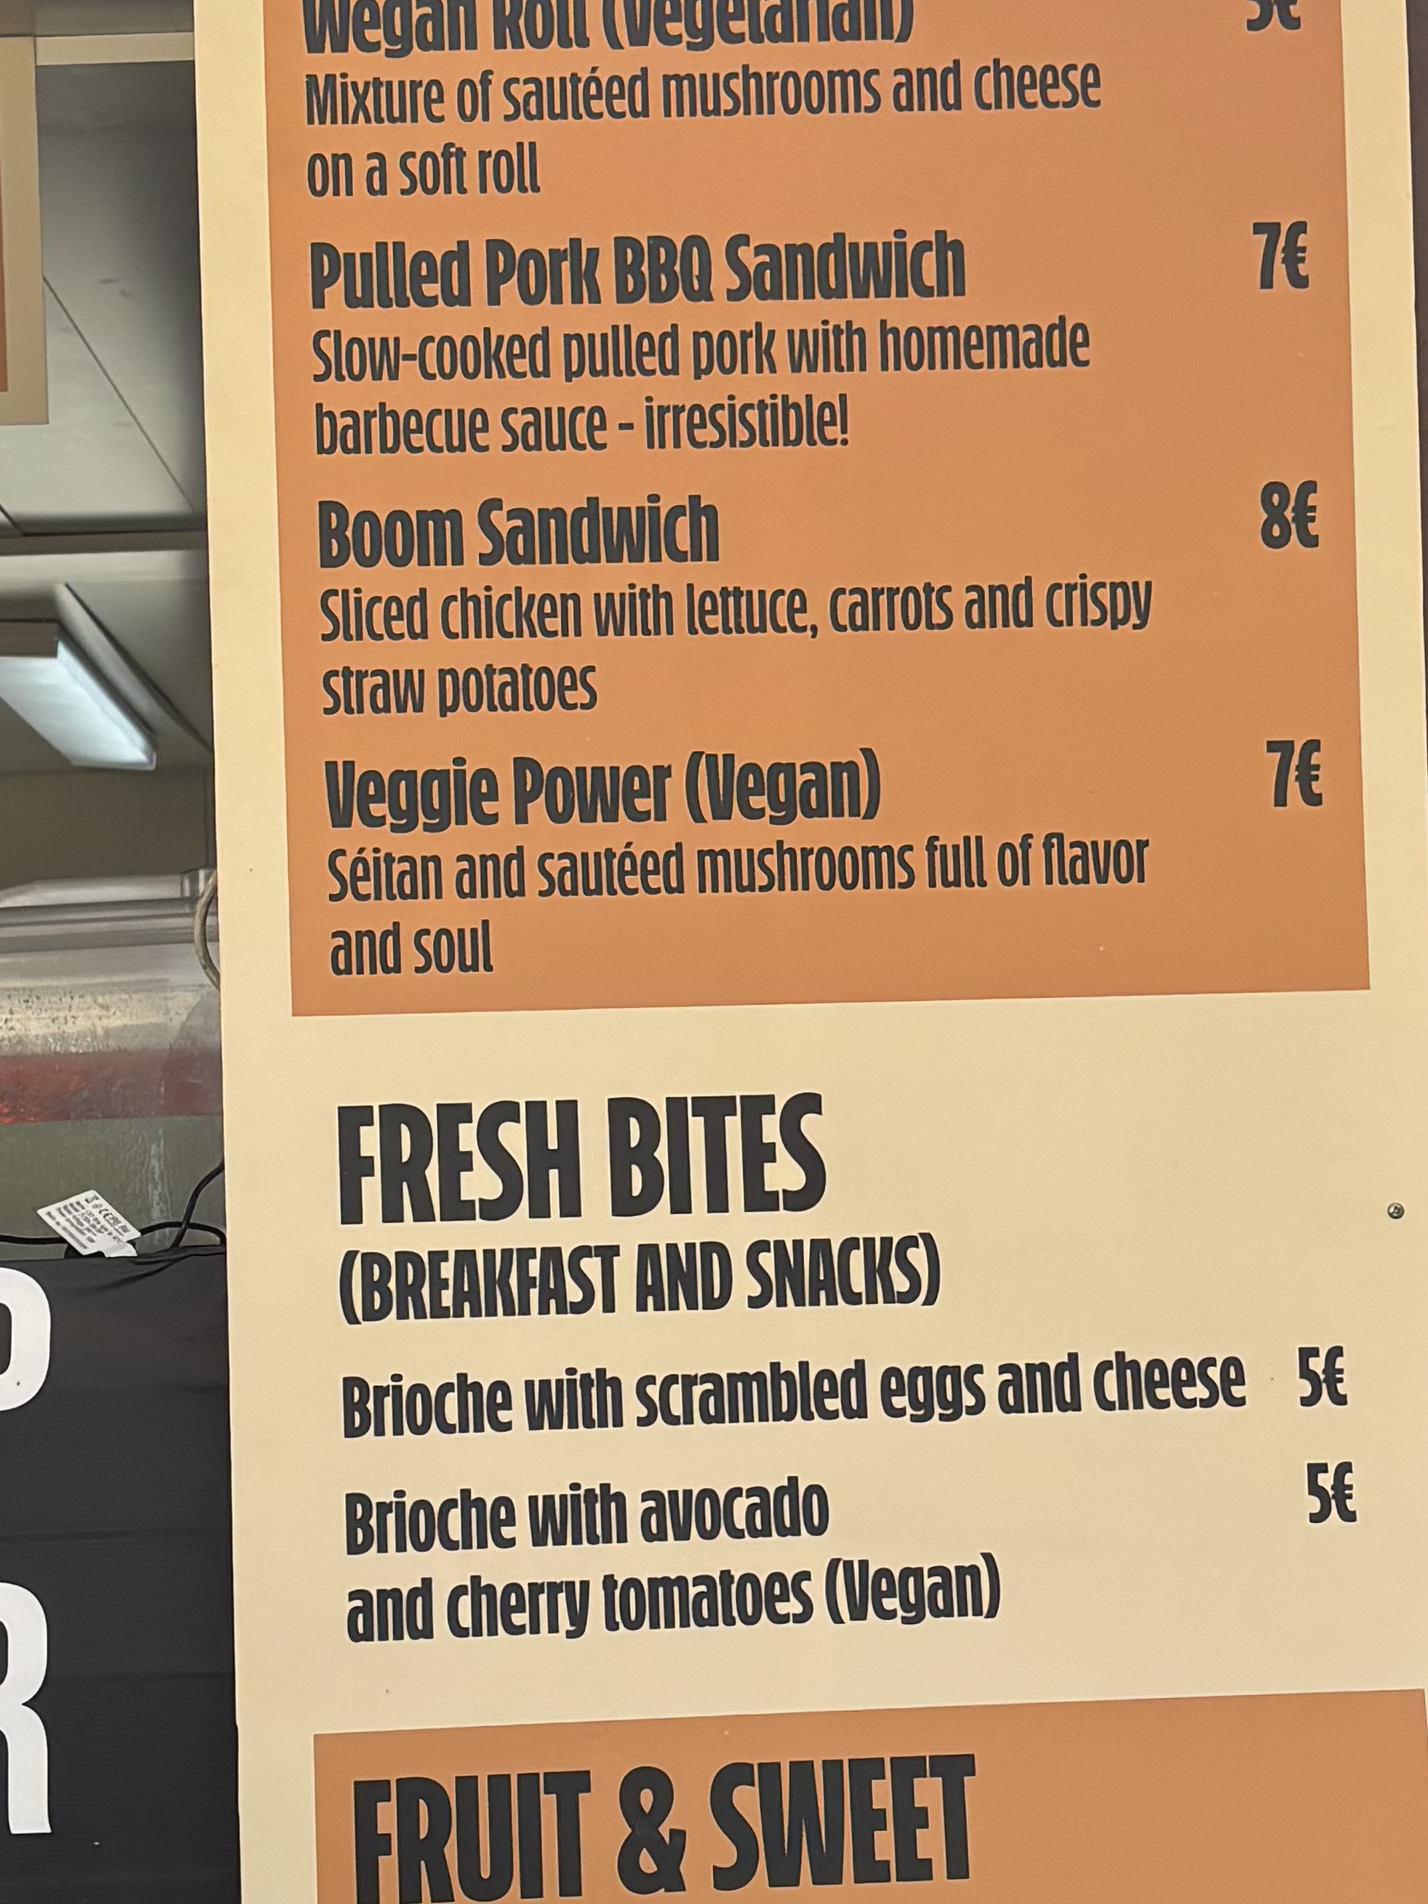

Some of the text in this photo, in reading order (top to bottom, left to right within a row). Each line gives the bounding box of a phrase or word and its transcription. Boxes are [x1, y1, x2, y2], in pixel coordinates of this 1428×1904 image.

[305, 57, 1102, 126] Mixture of sautéed mushrooms and cheese
[307, 141, 541, 198] on a soft roll
[310, 228, 967, 310] Pulled Pork BBQ Sandwich
[1252, 220, 1310, 290] 7€
[312, 314, 1091, 383] Slow-cooked pulled pork with homemade
[315, 401, 490, 456] barbecue
[500, 405, 608, 453] sauce
[644, 392, 849, 450] irresistible!
[317, 493, 720, 569] Boom Sandwich
[1260, 479, 1320, 550] 8€
[320, 572, 1153, 642] Sliced chicken with lettuce, carrots and crispy
[322, 663, 598, 718] straw potatoes
[324, 747, 881, 834] Veggie Power (Vegan)
[1265, 738, 1324, 808] 7€
[327, 831, 1150, 903] Séitan and sautéed mushrooms full of flavor
[330, 918, 494, 976] and soul
[337, 1091, 827, 1226] FRESH BITES
[339, 1232, 941, 1326] (BREAKFAST AND SNACKS)
[342, 1350, 1247, 1439] Brioche with scrambled eggs and cheese
[1297, 1345, 1349, 1408] 5€
[345, 1475, 830, 1556] Brioche with avocado
[1306, 1461, 1358, 1524] 5€
[346, 1552, 1001, 1644] and cherry tomatoes (Vegan)
[617, 1765, 687, 1896] &
[709, 1753, 977, 1892] SWEET
